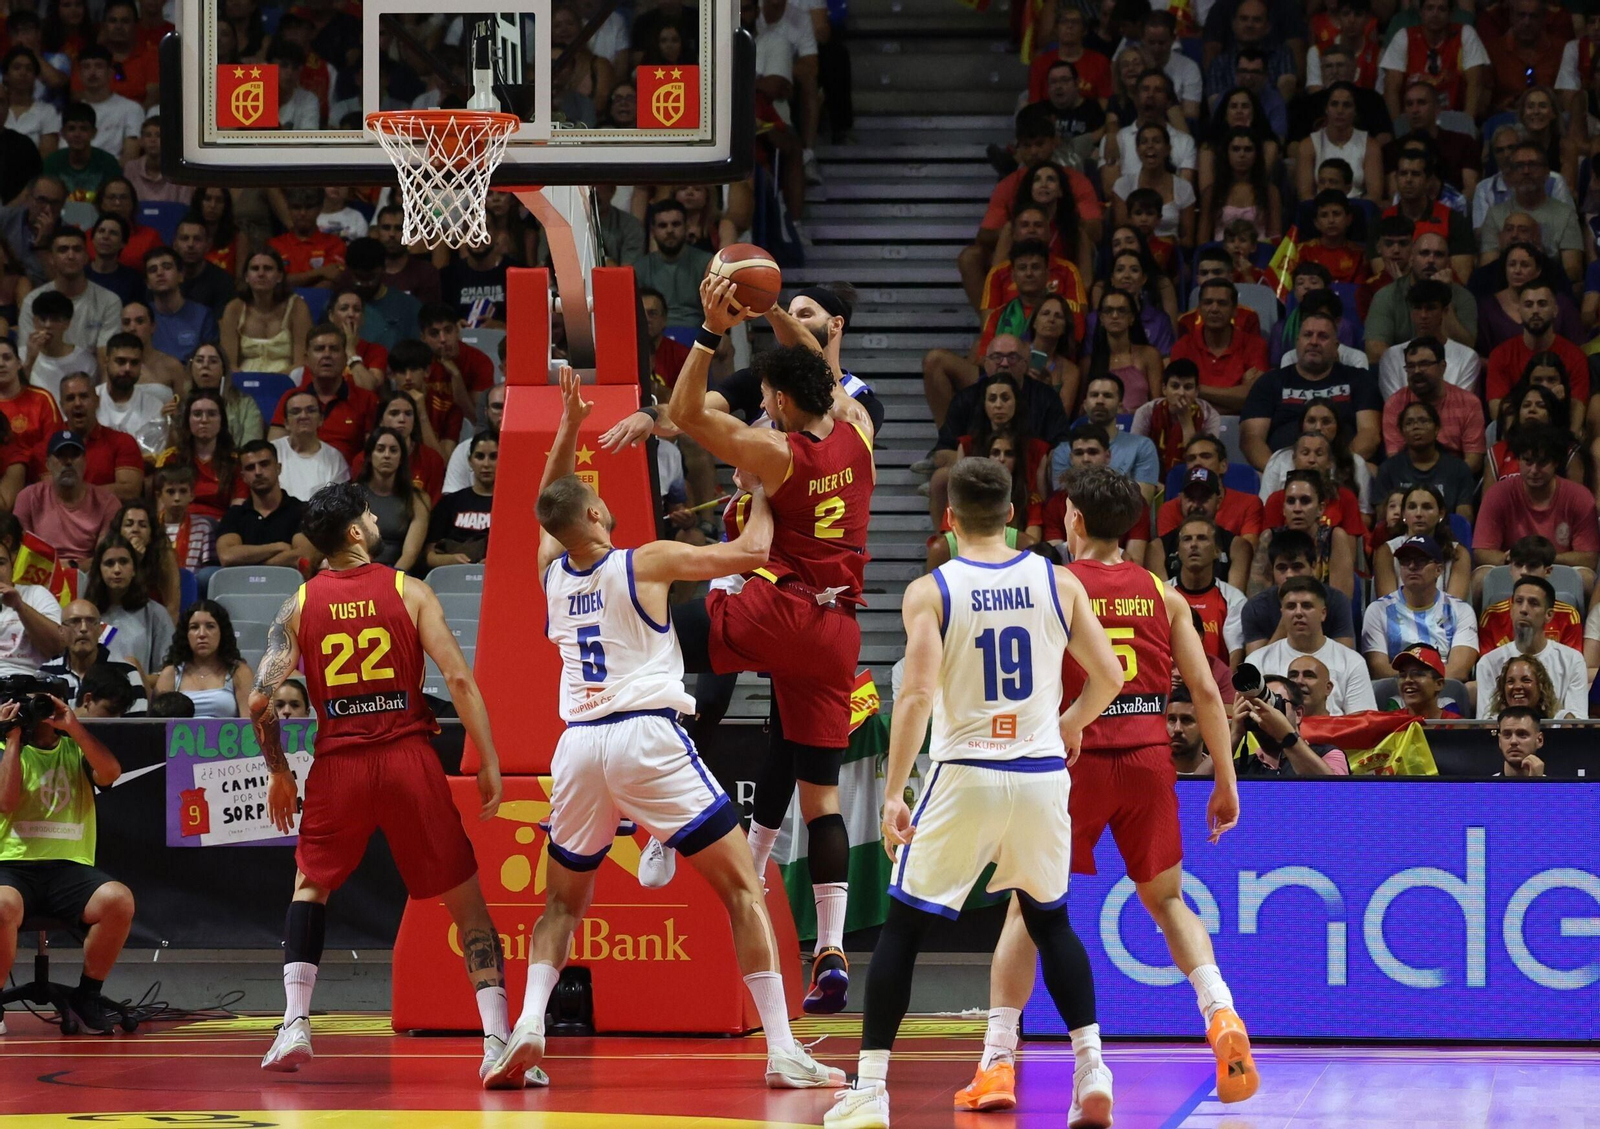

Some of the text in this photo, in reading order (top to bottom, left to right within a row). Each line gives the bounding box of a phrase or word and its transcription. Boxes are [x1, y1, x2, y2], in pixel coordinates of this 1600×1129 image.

[808, 466, 853, 496] PUERTO
[814, 496, 845, 538] 2
[329, 599, 377, 620] YUSTA
[567, 589, 604, 616] ZÍDEK
[971, 586, 1035, 612] SEHNAL
[321, 626, 395, 687] 22
[577, 624, 607, 682] 5
[975, 626, 1034, 701] 19
[334, 694, 405, 716] CaixaBank
[568, 701, 600, 716] SKUPINA
[968, 741, 1012, 751] SKUPIN
[233, 794, 254, 804] POR
[189, 805, 201, 826] 9
